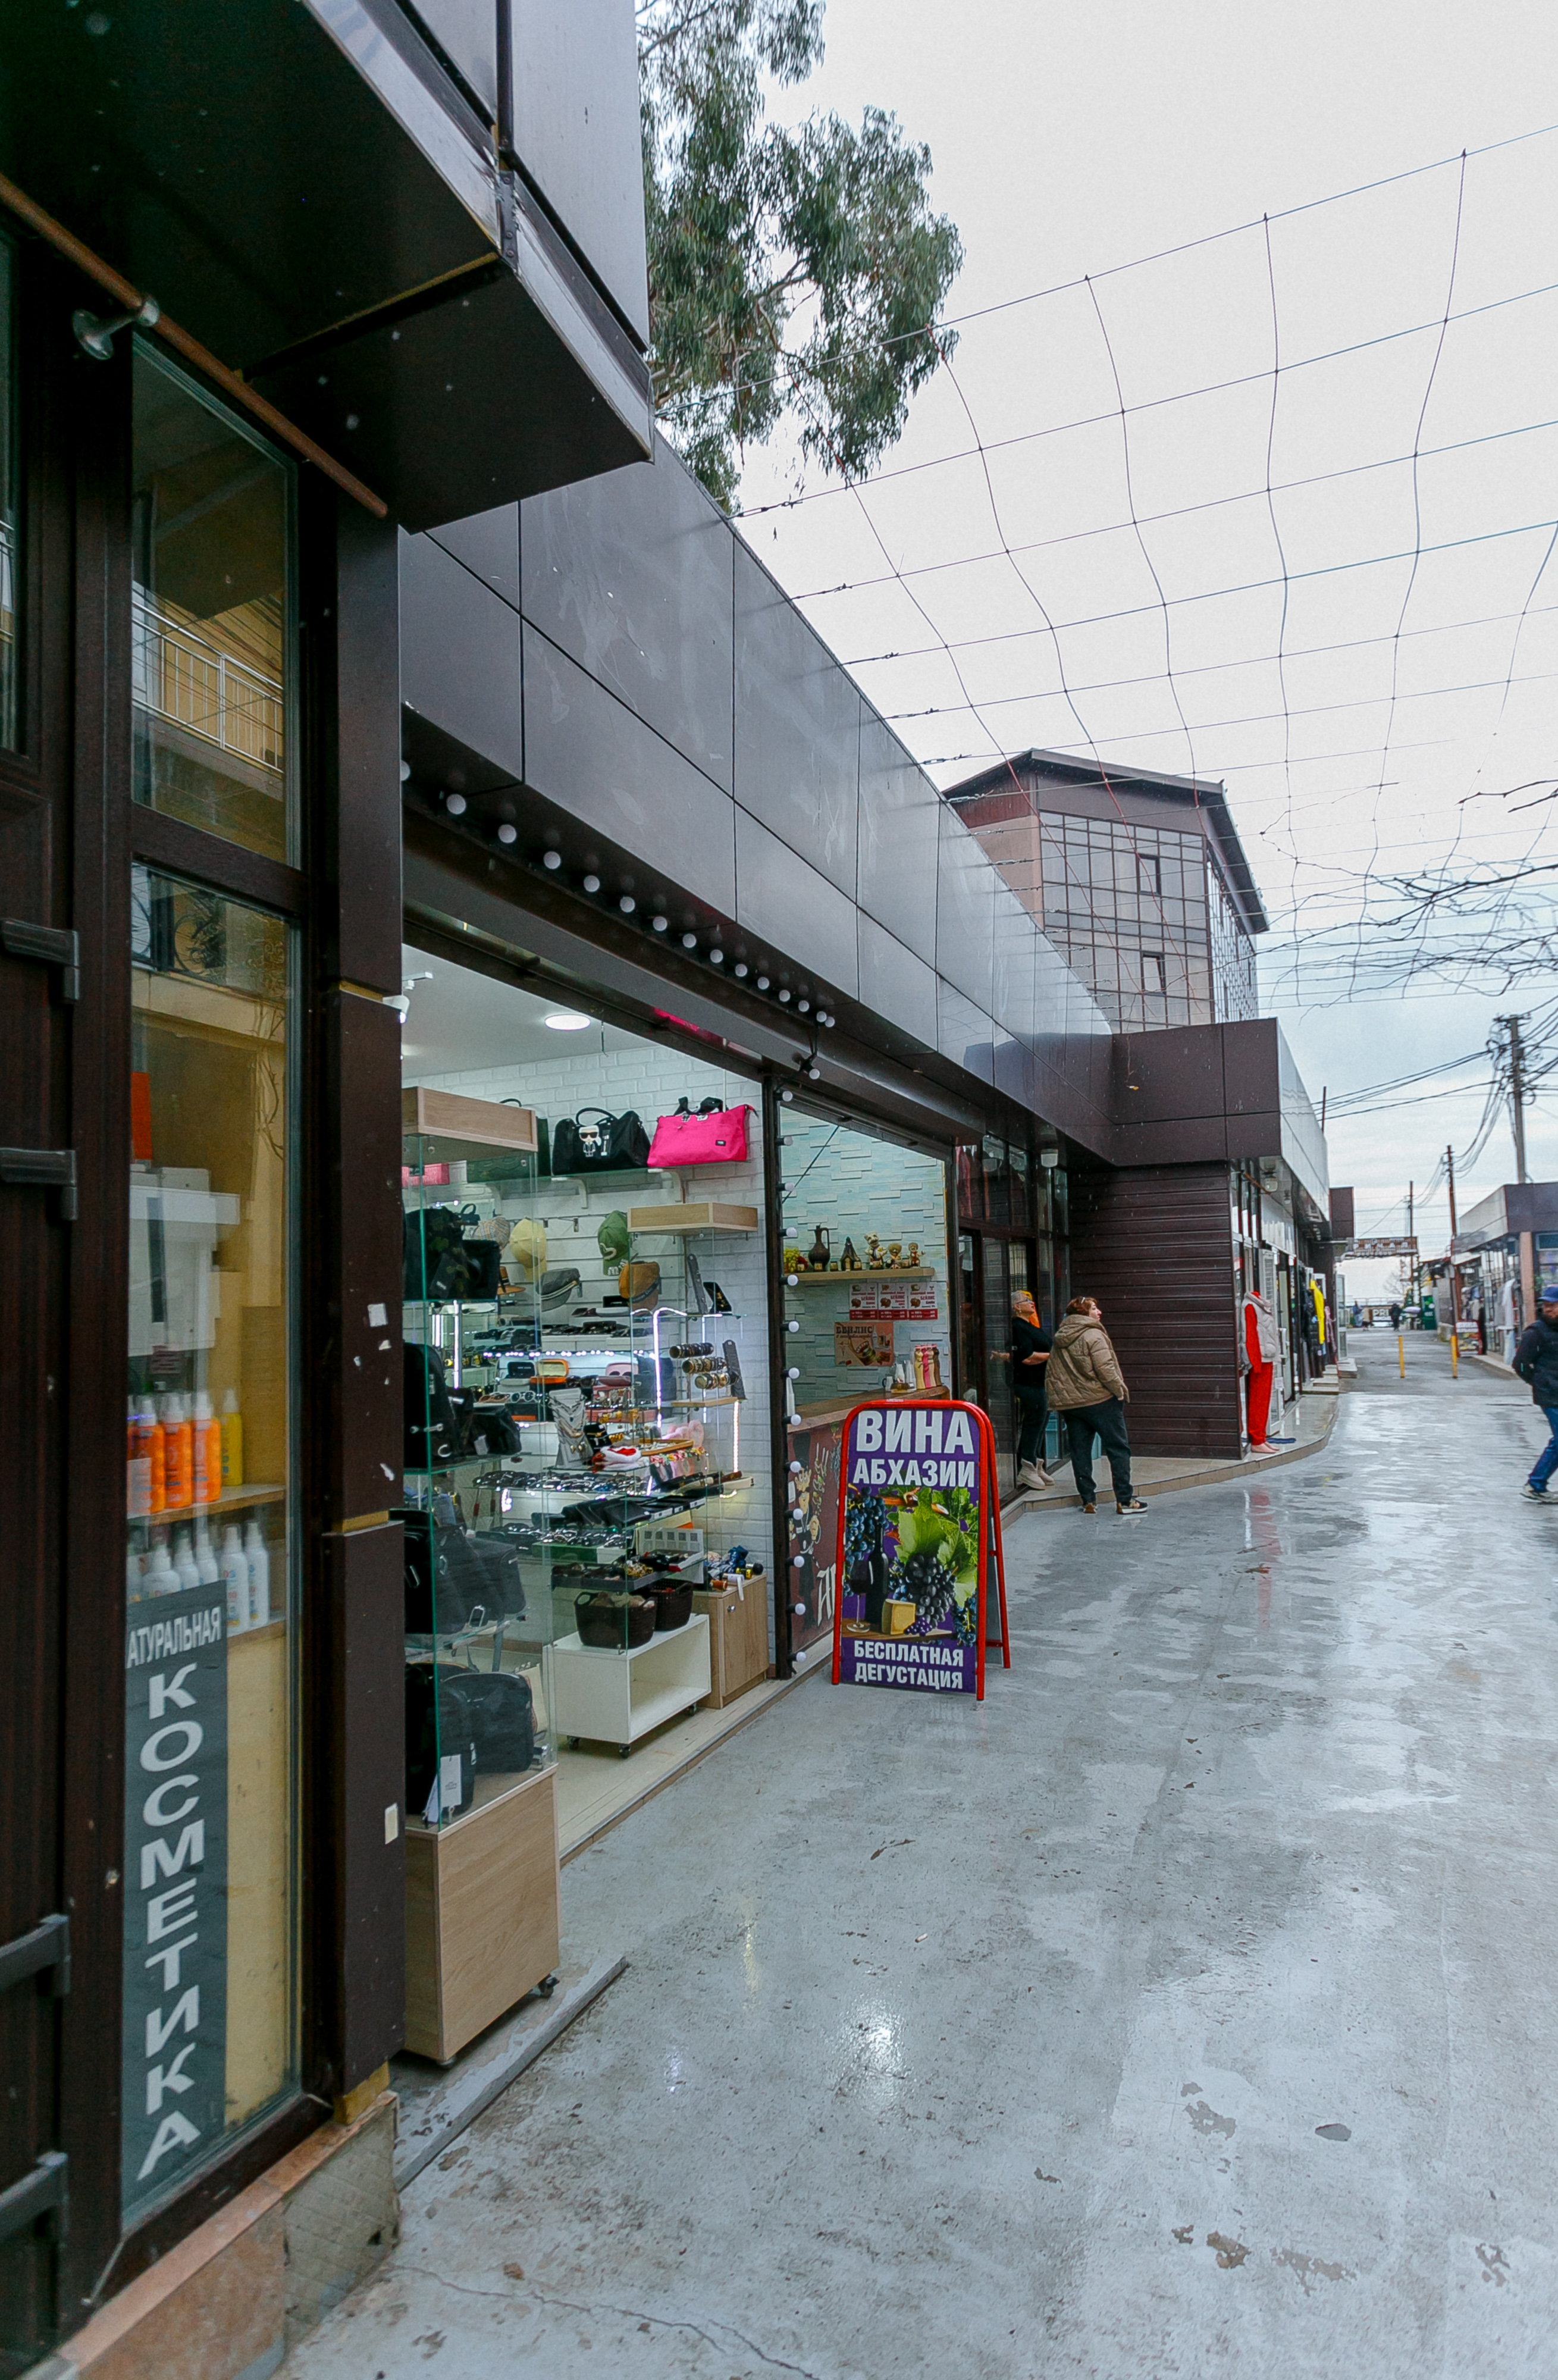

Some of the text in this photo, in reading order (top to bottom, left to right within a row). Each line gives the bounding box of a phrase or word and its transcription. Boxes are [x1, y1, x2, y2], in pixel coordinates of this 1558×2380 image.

[857, 1411, 974, 1454] ВИНА
[852, 1458, 974, 1488] АБХАЗИИ
[126, 1606, 222, 1669] АТУРАЛЬНАЯ
[854, 1640, 964, 1667] БЕСПЛАТНАЯ
[855, 1662, 963, 1690] ДЕГУСТАЦИЯ
[137, 1662, 205, 2181] КОСМЕТИКА
